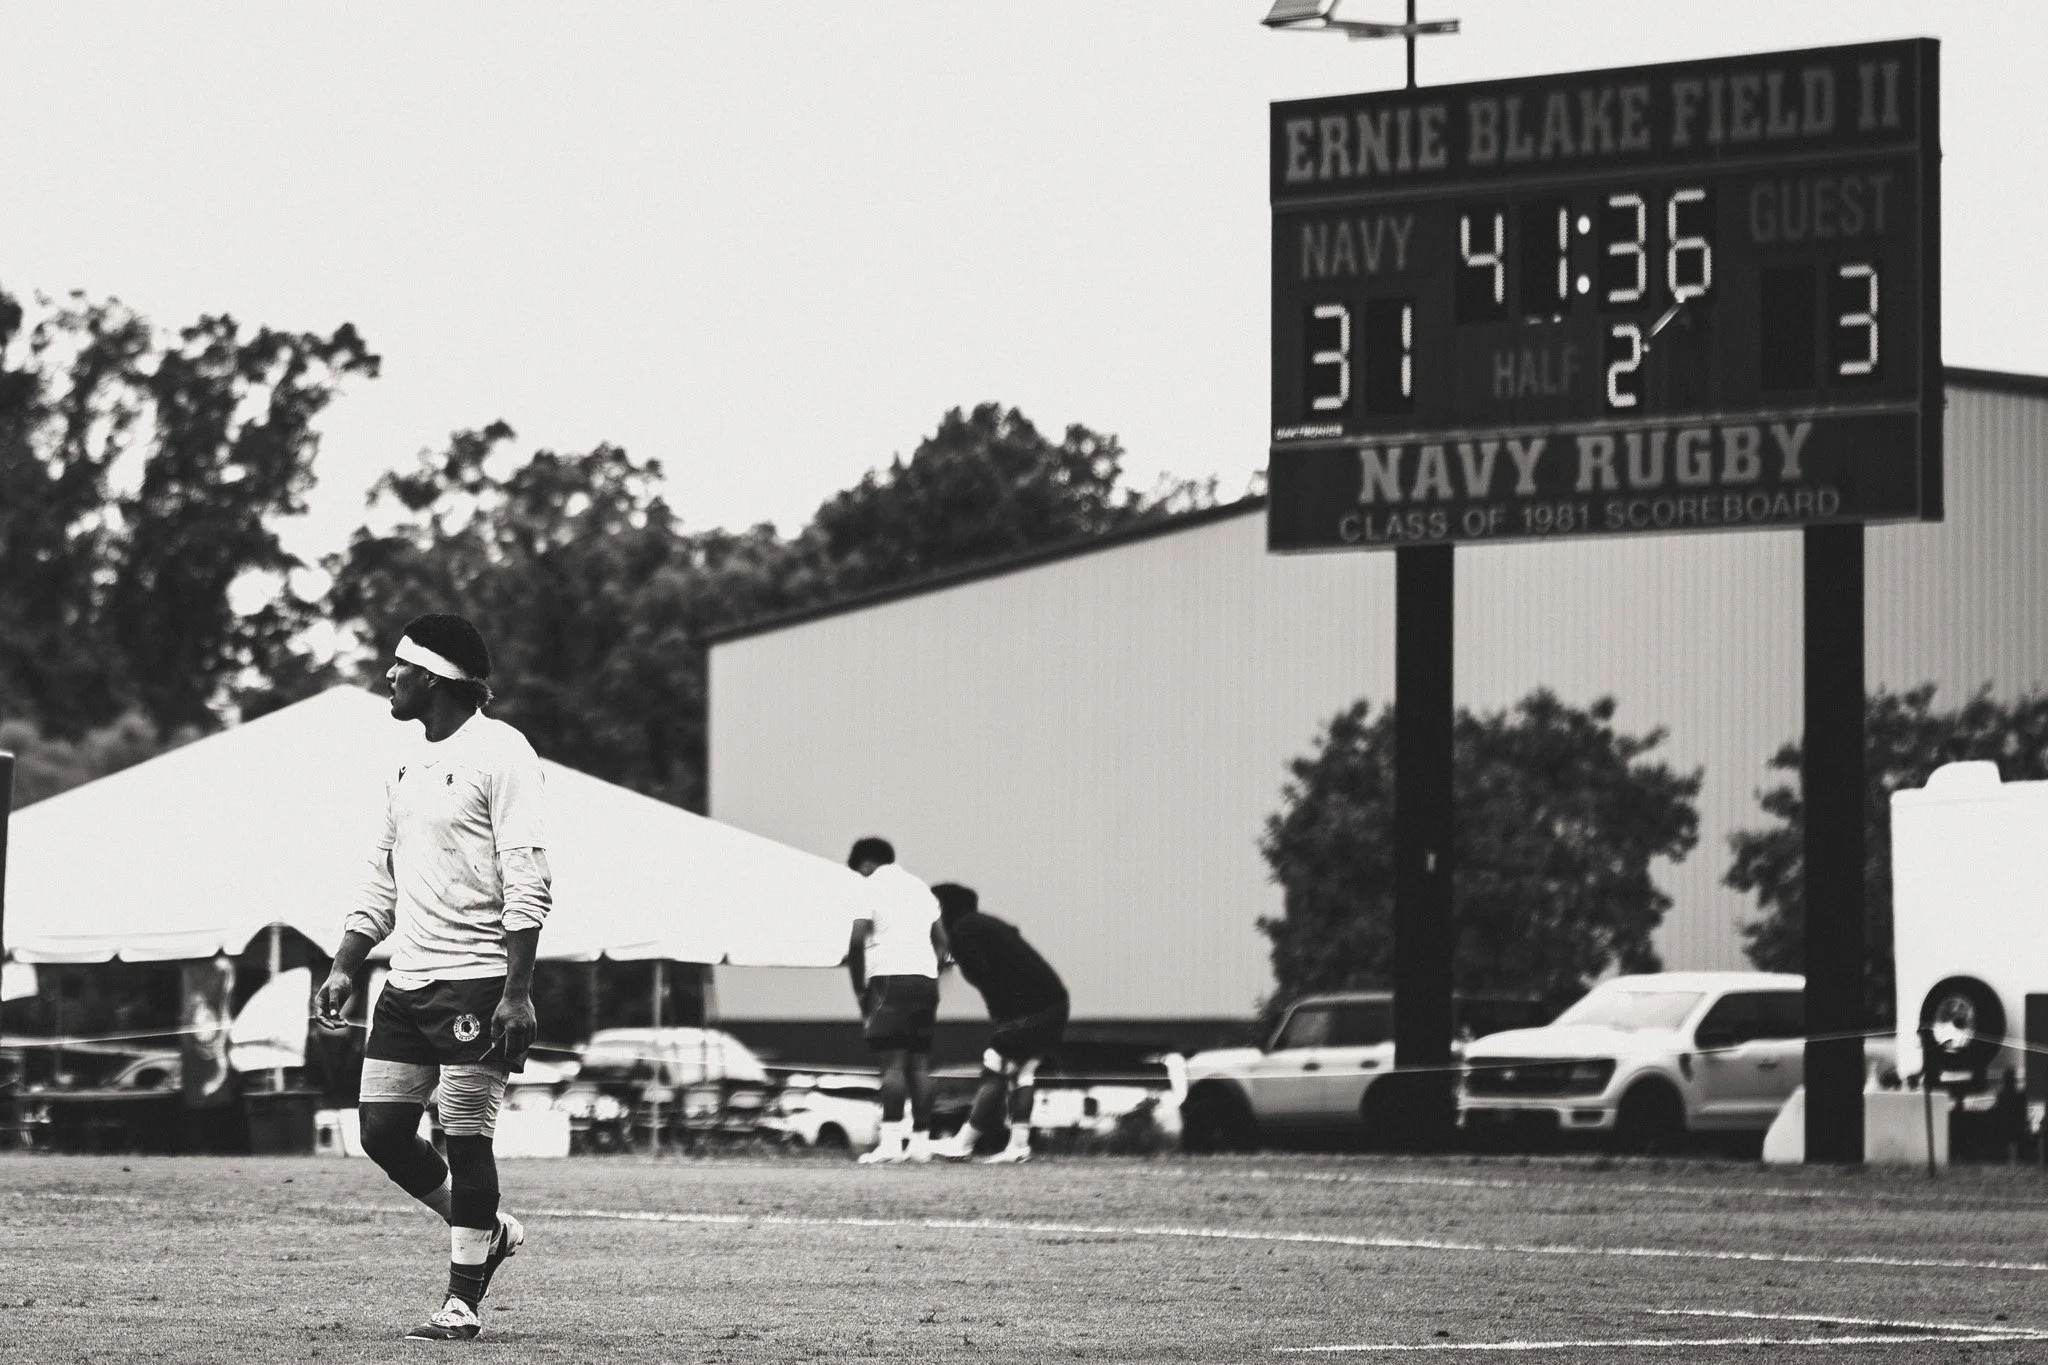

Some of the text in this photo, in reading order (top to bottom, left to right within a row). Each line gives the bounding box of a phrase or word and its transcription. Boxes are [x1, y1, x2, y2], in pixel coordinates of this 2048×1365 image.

[1286, 62, 1900, 182] ERNIE BLAKE FIELD II
[1302, 214, 1414, 279] NAVY
[1460, 188, 1712, 303] 41:36
[1750, 174, 1892, 244] GUEST
[1312, 303, 1412, 411] 31
[1839, 264, 1879, 376] 3
[1495, 347, 1581, 399] HALF
[1607, 324, 1642, 408] 2
[1359, 422, 1814, 504] NAVY RUGBY
[1339, 486, 1840, 543] CLASS OF 1981 SCOREBOARD
